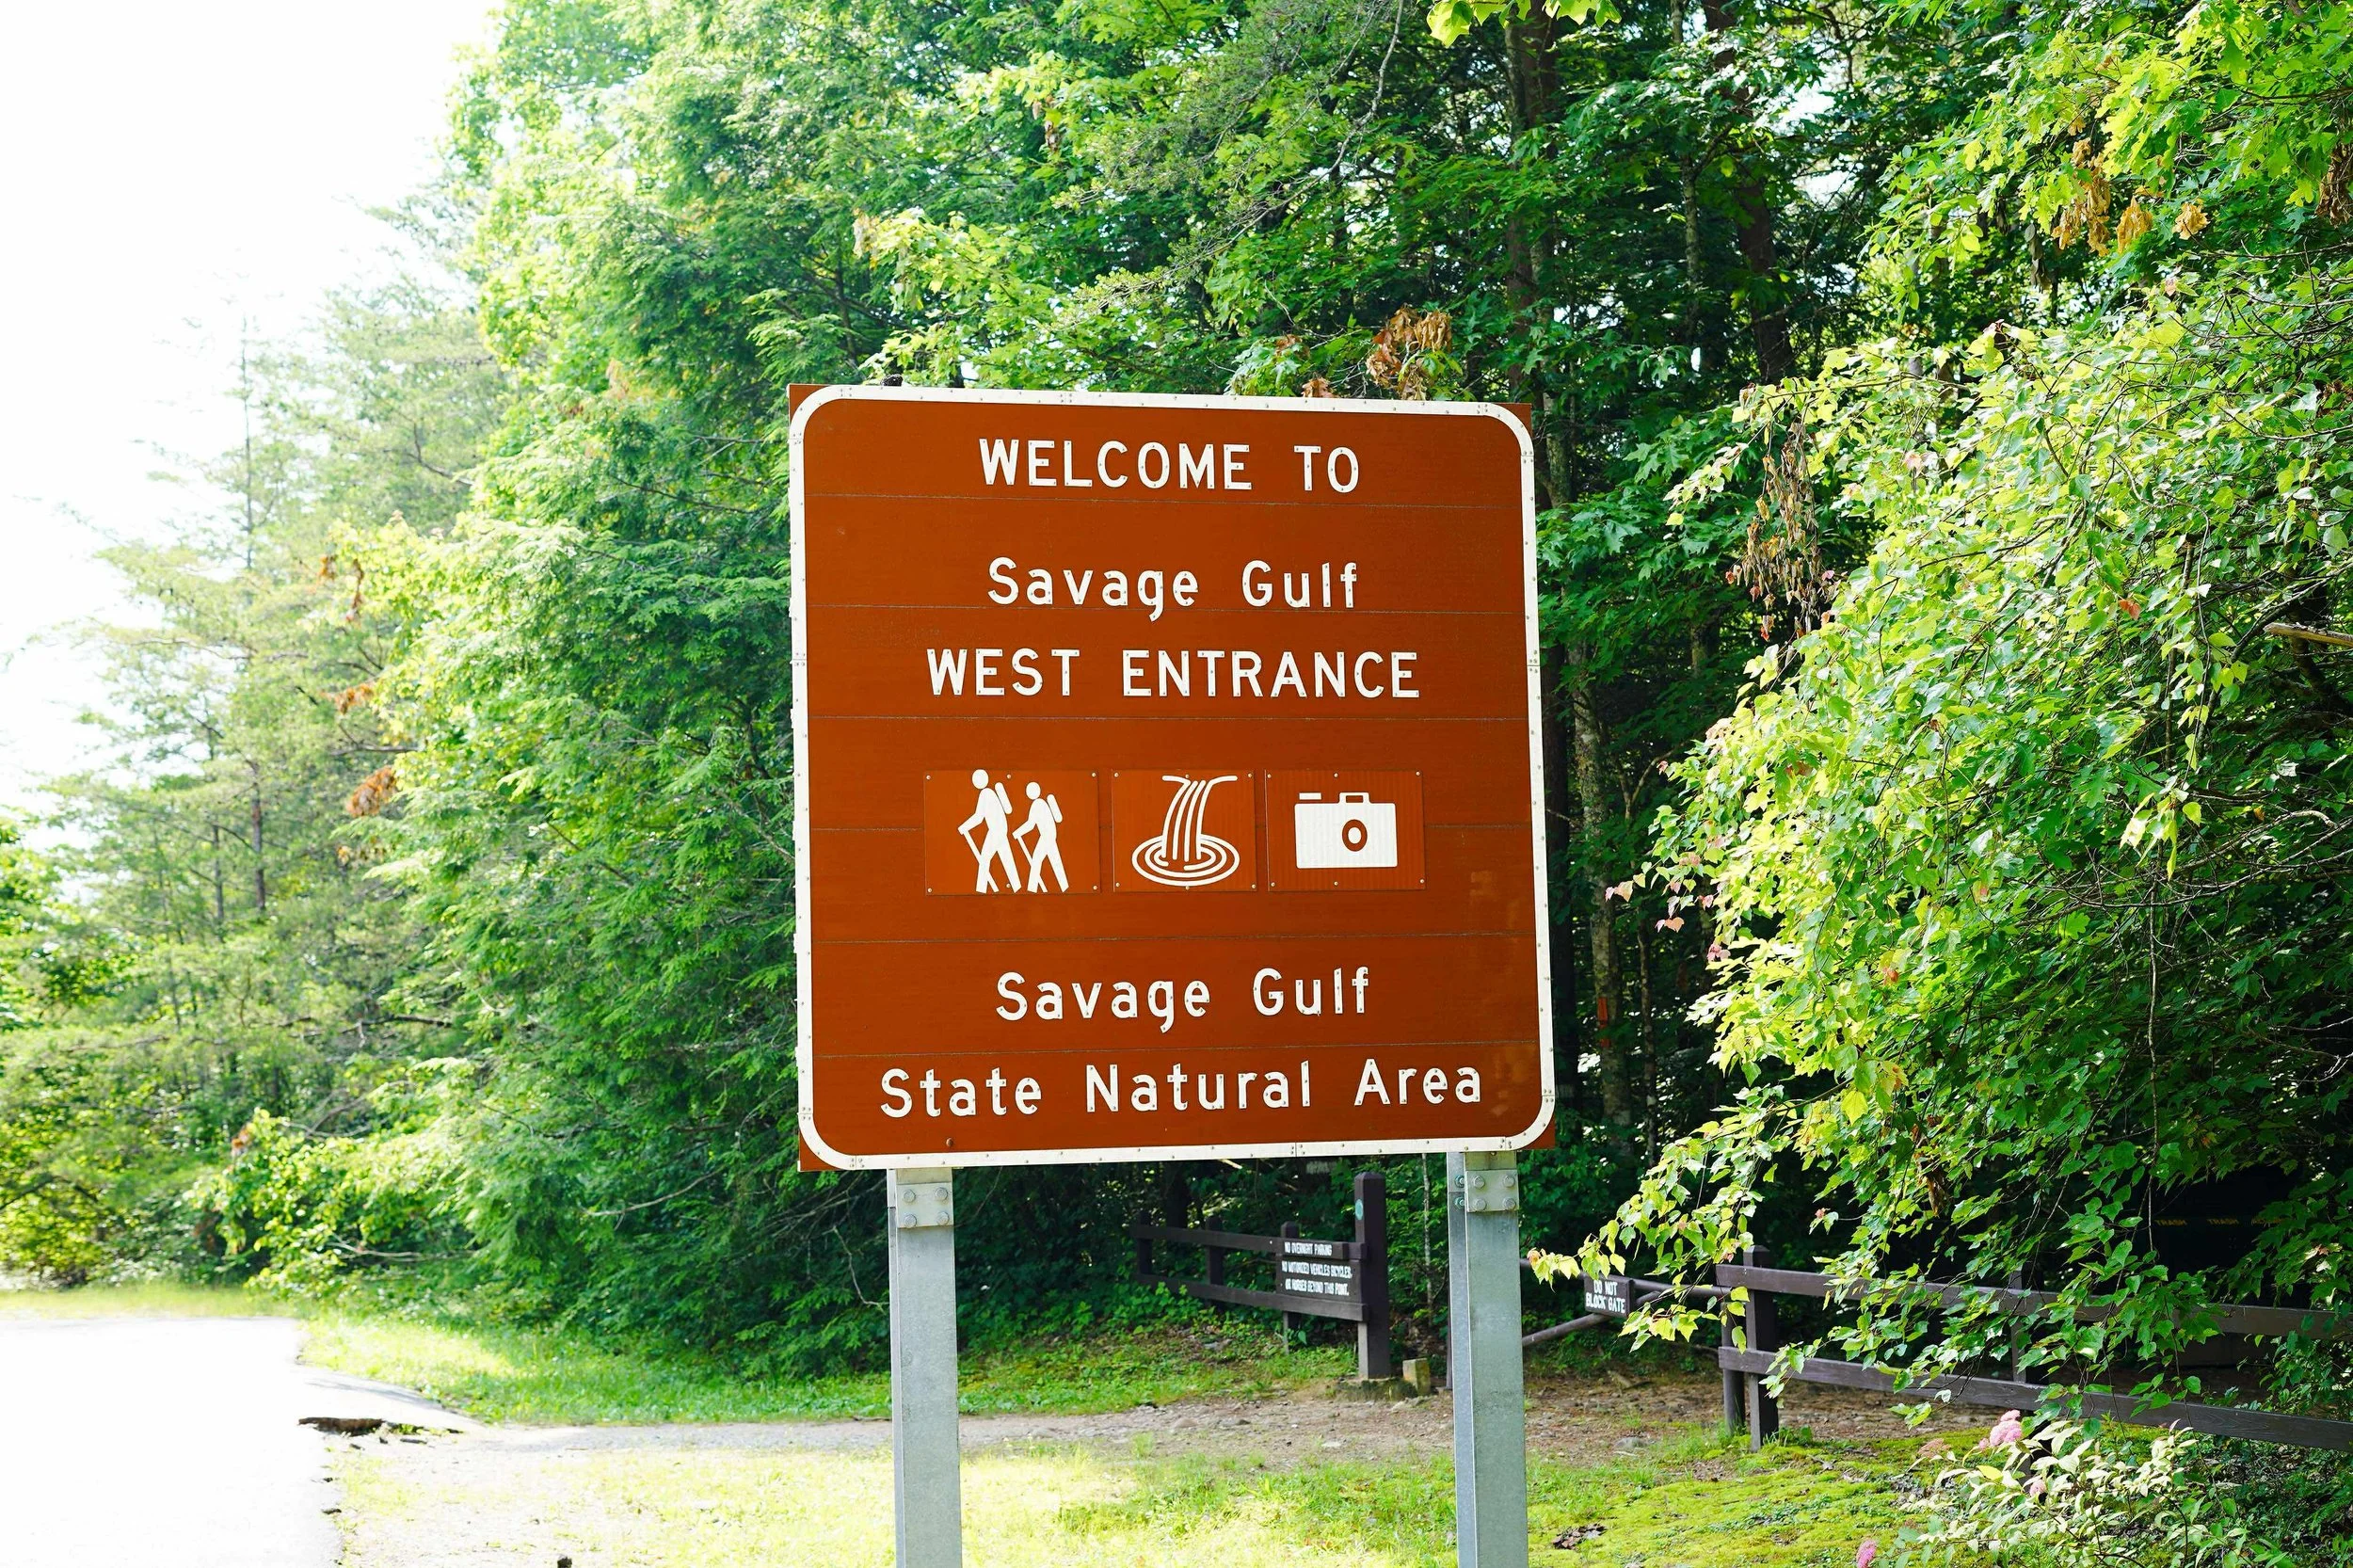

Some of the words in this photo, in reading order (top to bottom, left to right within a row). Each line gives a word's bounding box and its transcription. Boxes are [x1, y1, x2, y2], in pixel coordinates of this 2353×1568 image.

[980, 439, 1251, 489] WELCOME
[1294, 446, 1358, 492] TO
[988, 557, 1198, 621] Savage
[1242, 560, 1356, 607] Gulf
[927, 648, 1080, 696] WEST
[1123, 650, 1419, 697] ENTRANCE
[997, 972, 1209, 1032] Savage
[1253, 967, 1369, 1016] Gulf
[881, 1068, 1041, 1117] State
[1087, 1061, 1310, 1112] Natural
[1354, 1059, 1480, 1105] Area
[1284, 1241, 1291, 1254] NO
[1291, 1242, 1314, 1255] OVERNIGHT
[1314, 1243, 1333, 1256] PARKING
[1281, 1260, 1288, 1272] NO
[1288, 1261, 1310, 1274] MOTORIZED
[1310, 1263, 1330, 1276] VEHICLES
[1285, 1278, 1291, 1290] OR
[1291, 1279, 1307, 1292] HORSES
[1307, 1280, 1323, 1293] BEYOND
[1323, 1282, 1335, 1295] THIS
[1586, 1292, 1607, 1309] BLOCK
[1608, 1296, 1625, 1313] GATE
[1593, 1280, 1603, 1294] DO
[1605, 1281, 1618, 1295] NOT
